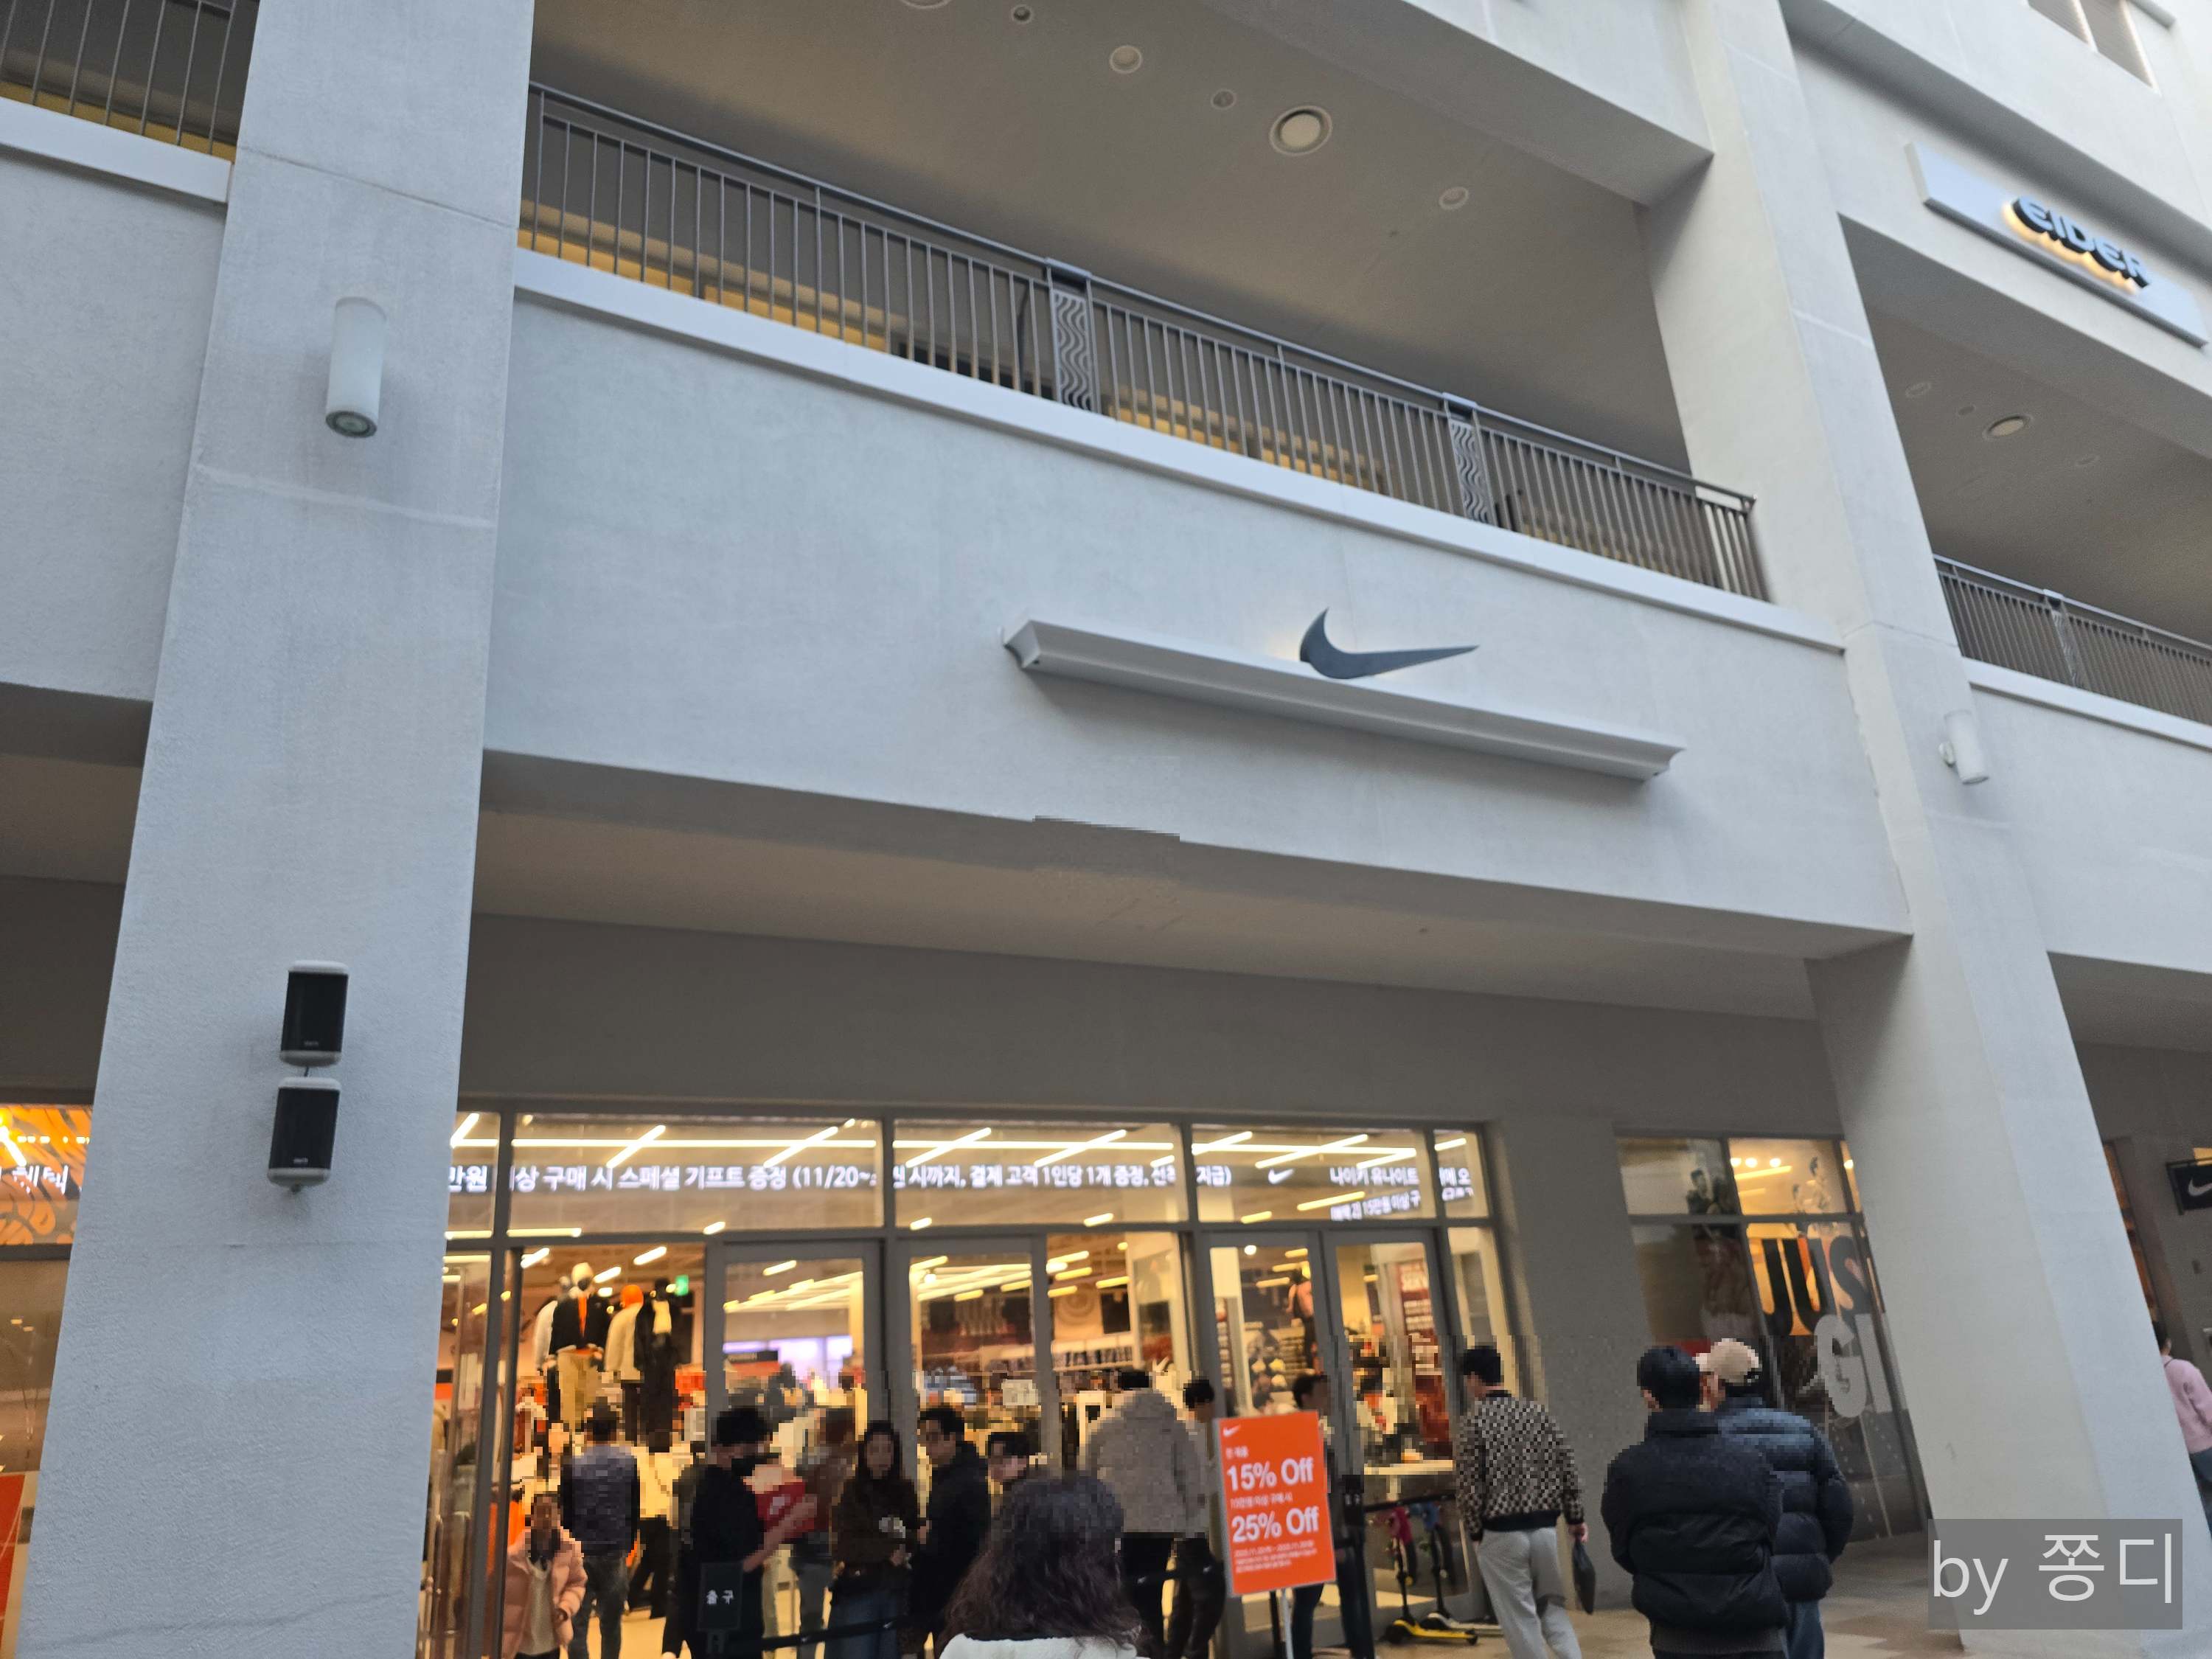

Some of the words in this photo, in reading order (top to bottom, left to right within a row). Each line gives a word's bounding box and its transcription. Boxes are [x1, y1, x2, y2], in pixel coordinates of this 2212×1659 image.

[543, 1165, 588, 1192] 구매
[591, 1166, 613, 1191] 시
[616, 1164, 681, 1192] 스페셜
[684, 1165, 745, 1190] 기프트
[1086, 1164, 1112, 1187] 1개
[1329, 1166, 1369, 1186] 나이키
[1371, 1166, 1420, 1186] 유나이트
[1227, 1461, 1277, 1491] 15%
[1281, 1457, 1314, 1485] Off
[1231, 1511, 1283, 1543] 25%
[1286, 1506, 1320, 1535] Off
